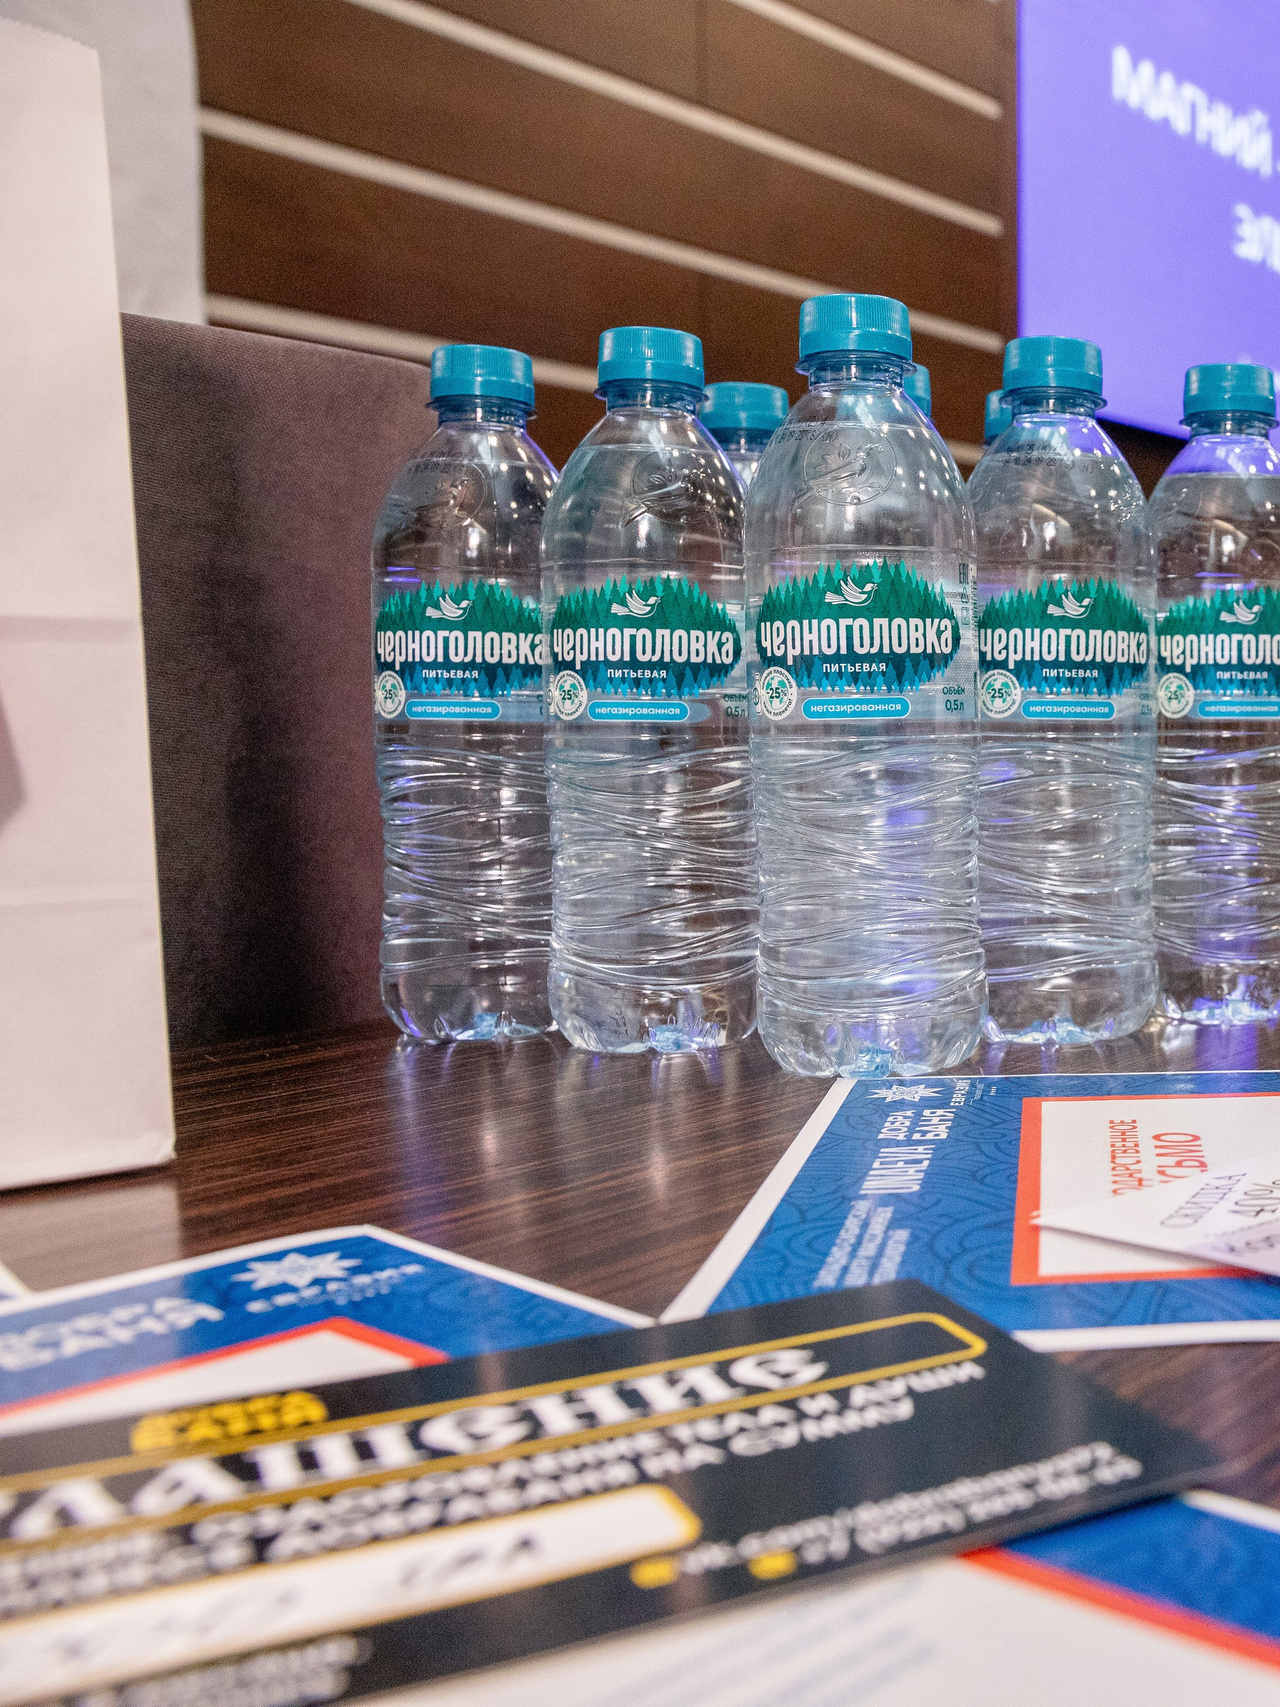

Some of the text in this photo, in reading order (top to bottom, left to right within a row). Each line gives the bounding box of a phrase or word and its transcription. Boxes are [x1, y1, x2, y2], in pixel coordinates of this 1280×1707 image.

[1111, 43, 1273, 178] МАГНИЙ
[553, 626, 733, 670] черноголовка
[760, 618, 953, 666] черноголовка
[979, 626, 1147, 669] черноголовка
[376, 630, 551, 673] черноголовка
[422, 668, 479, 679] ПИТЬЕВАЯ
[607, 667, 667, 679] ПИТЬЕВАЯ
[822, 662, 887, 673] ПИТЬЕВАЯ
[1042, 668, 1098, 679] ПИТЬЕВАЯ
[1216, 670, 1268, 680] ПИТЬЕВАЯ
[382, 689, 398, 700] -25%
[559, 689, 579, 701] -25%
[766, 687, 788, 700] -25%
[987, 688, 1011, 699] -25%
[411, 704, 492, 715] негазированная
[595, 704, 681, 716] негазированная
[810, 703, 902, 714] негазированная
[945, 699, 965, 712] 0,5л
[1029, 703, 1109, 714] негазированная
[1204, 704, 1279, 714] негазированная
[877, 1109, 916, 1140] ДОБРА
[912, 1108, 957, 1141] БАНЯ
[1109, 1118, 1153, 1197] ОДАРСТВЕННОЕ
[1157, 1131, 1209, 1183] СЬМО
[860, 1144, 936, 1195] UNAEVA
[1158, 1171, 1248, 1229] СКИДКА
[0, 1348, 829, 1543] ЛАШЕНИЕ
